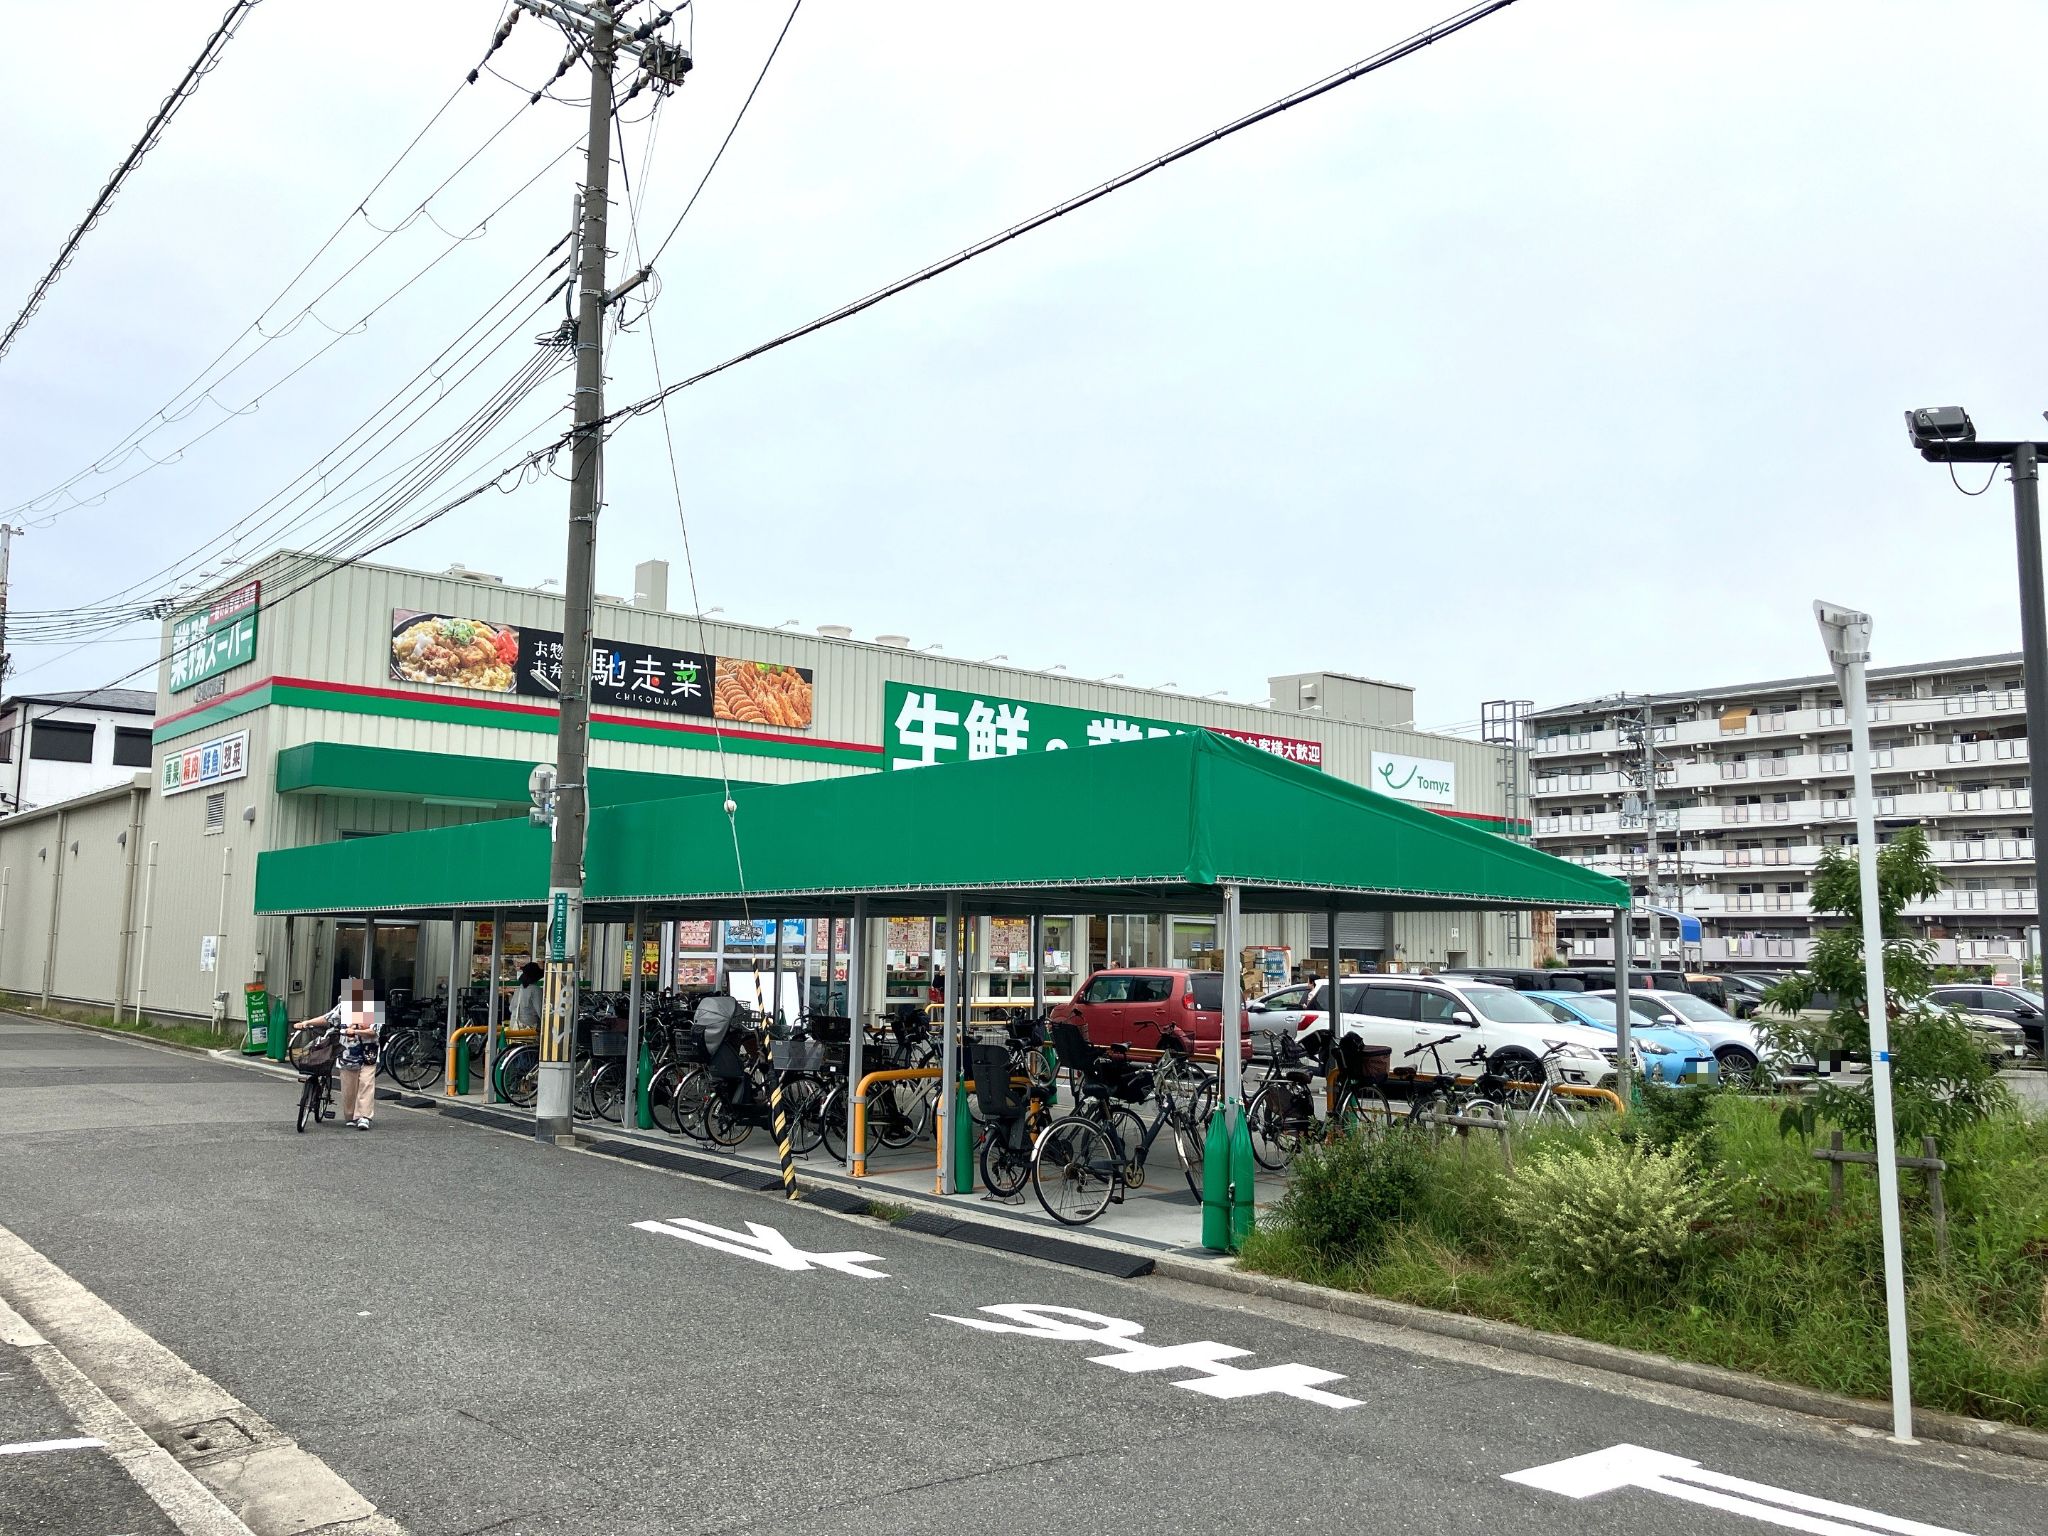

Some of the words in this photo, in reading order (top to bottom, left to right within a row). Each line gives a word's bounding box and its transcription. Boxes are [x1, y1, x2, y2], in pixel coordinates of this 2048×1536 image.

[170, 615, 253, 688] 業務スーパー
[591, 648, 702, 698] 馳走菜
[615, 691, 678, 707] CHISOUNA
[183, 754, 199, 781] 精肉
[202, 748, 219, 776] 鮮魚
[1417, 775, 1450, 795] Tomyz
